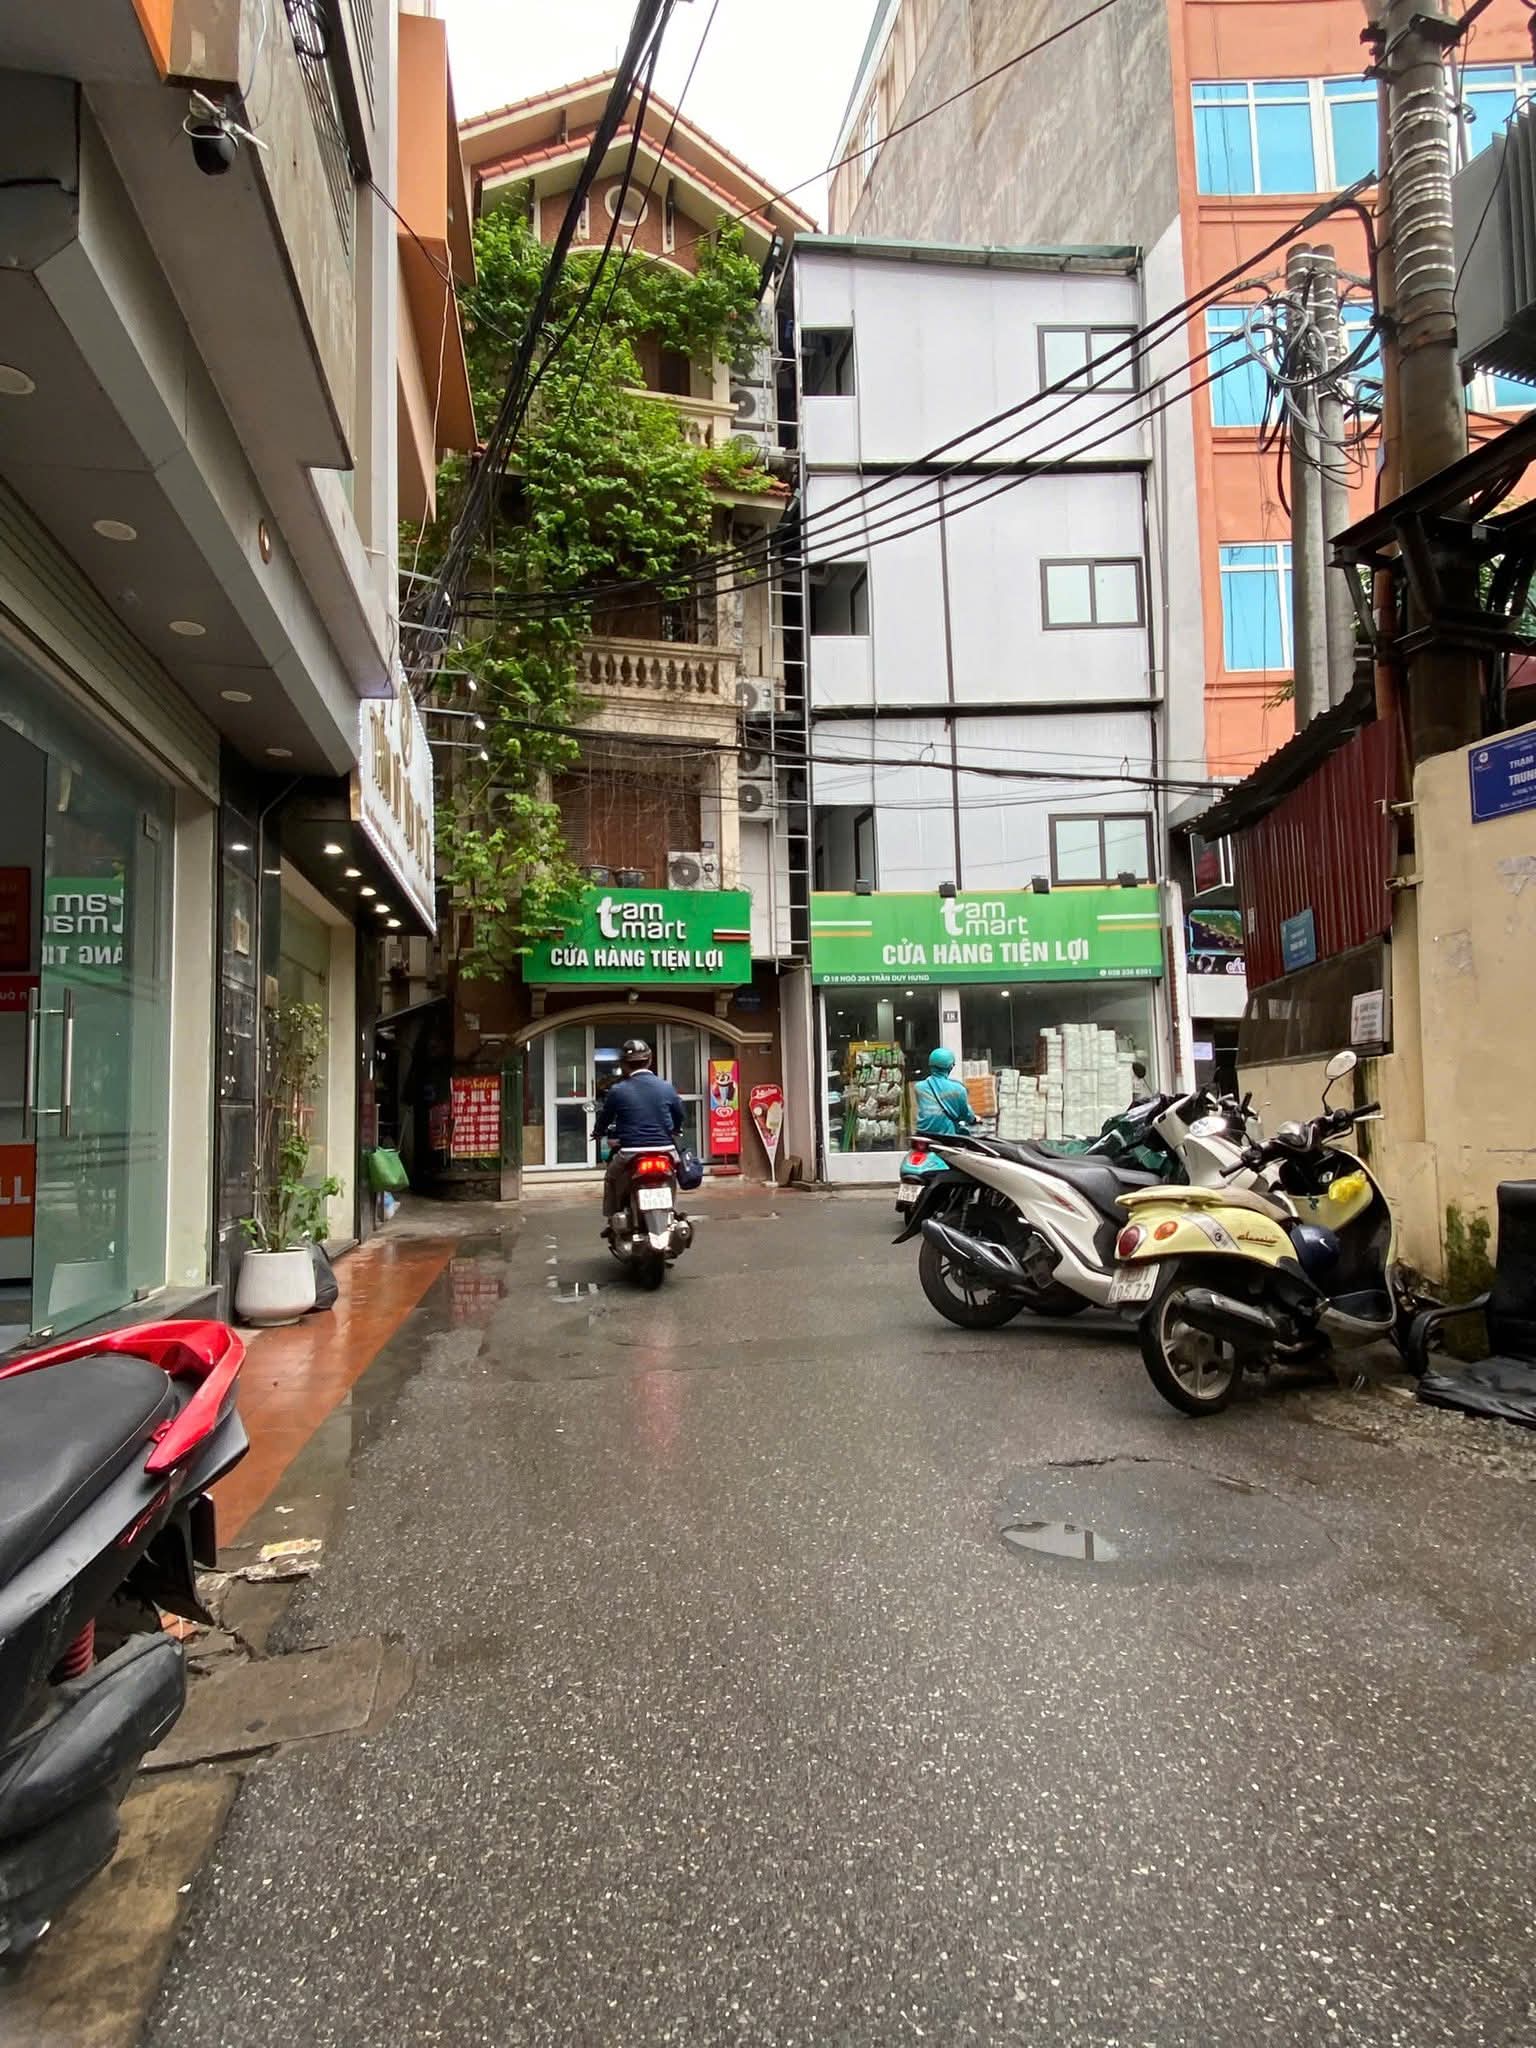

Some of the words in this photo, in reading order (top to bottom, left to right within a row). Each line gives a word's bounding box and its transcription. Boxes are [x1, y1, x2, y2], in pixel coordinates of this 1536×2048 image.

[621, 920, 687, 939] mart
[966, 917, 1029, 936] mart
[551, 943, 588, 966] CỬA
[594, 944, 645, 967] HÀNG
[652, 946, 690, 970] TIỆN
[695, 947, 723, 972] LỢI
[883, 938, 926, 965] CỬA
[933, 940, 993, 965] HÀNG
[999, 938, 1048, 967] TIỆN
[1056, 939, 1089, 966] LỢI
